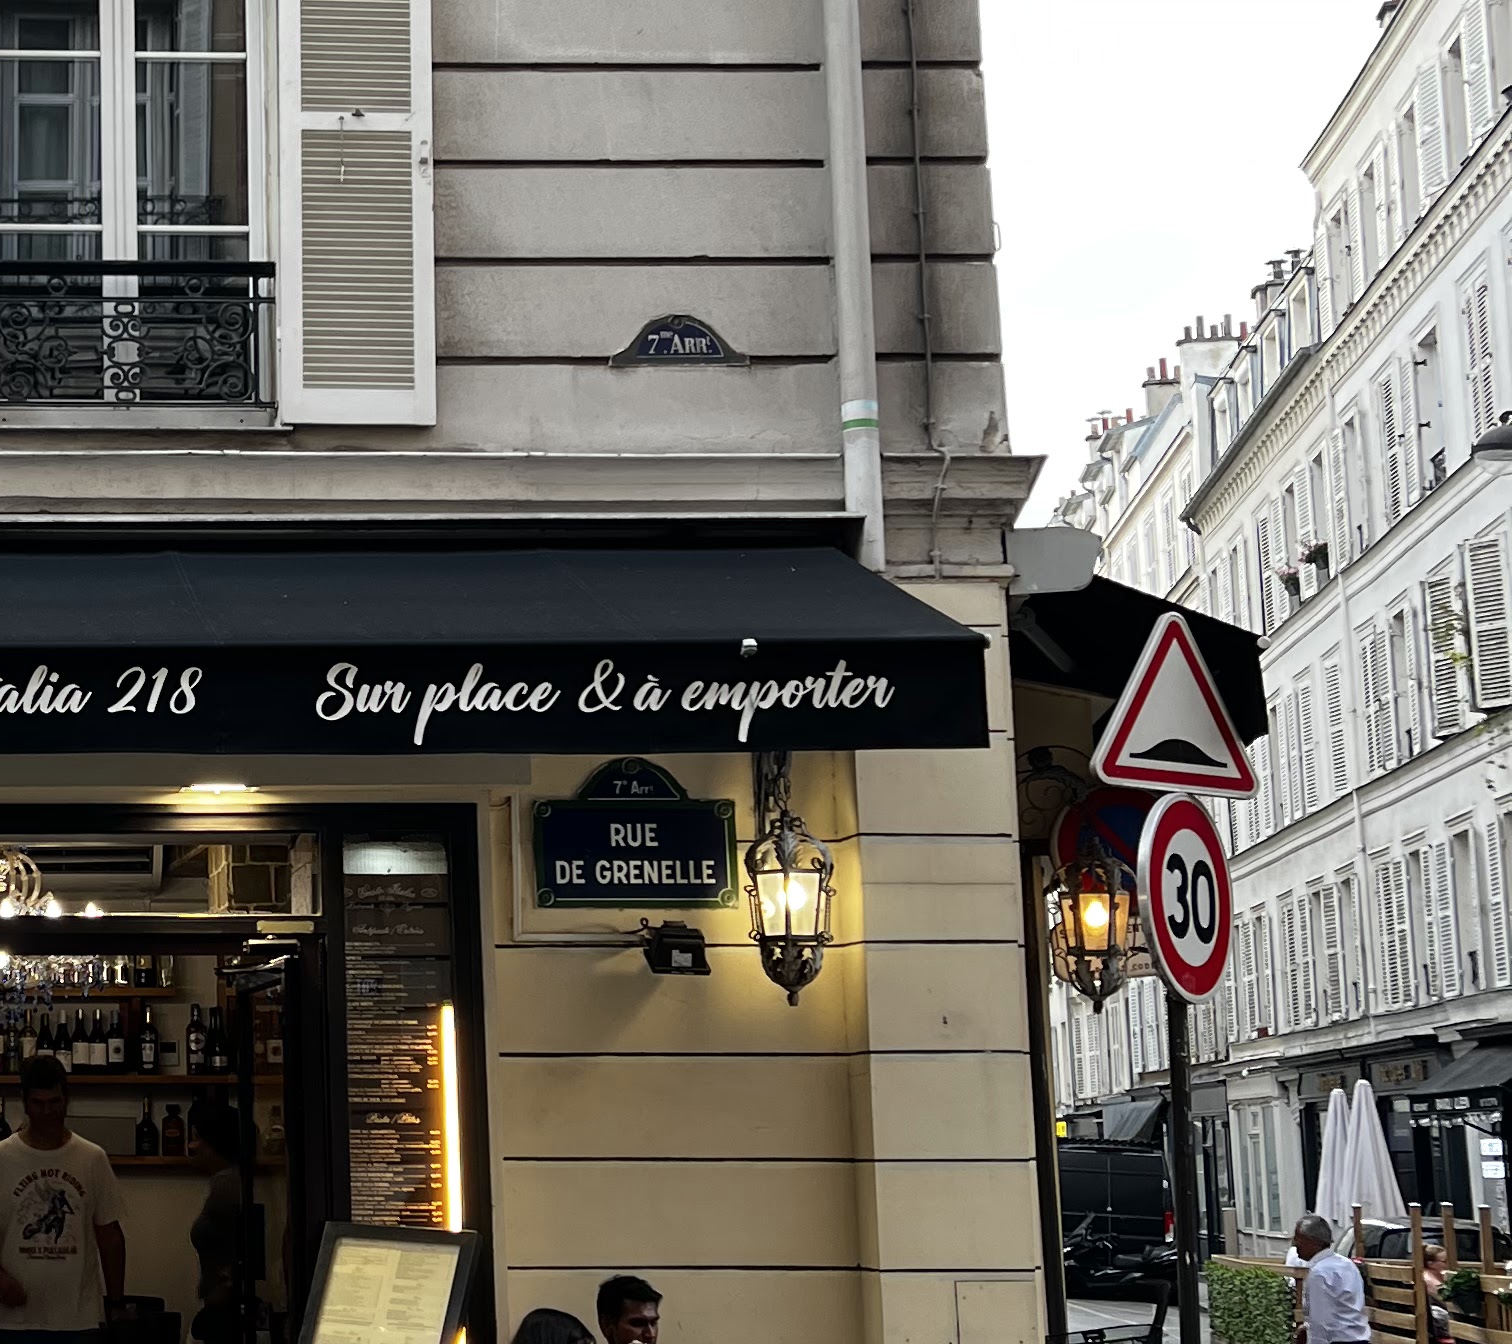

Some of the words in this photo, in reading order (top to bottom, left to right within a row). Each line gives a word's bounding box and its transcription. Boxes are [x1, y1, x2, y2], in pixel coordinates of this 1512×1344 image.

[106, 666, 203, 715] 218
[315, 662, 412, 721] Sur
[413, 662, 562, 746] place
[577, 659, 626, 713] &
[633, 674, 673, 712] à
[680, 659, 896, 743] emporter
[610, 823, 659, 847] RUE
[555, 860, 586, 885] DE
[595, 859, 717, 885] GRENELLE
[1166, 852, 1216, 945] 30
